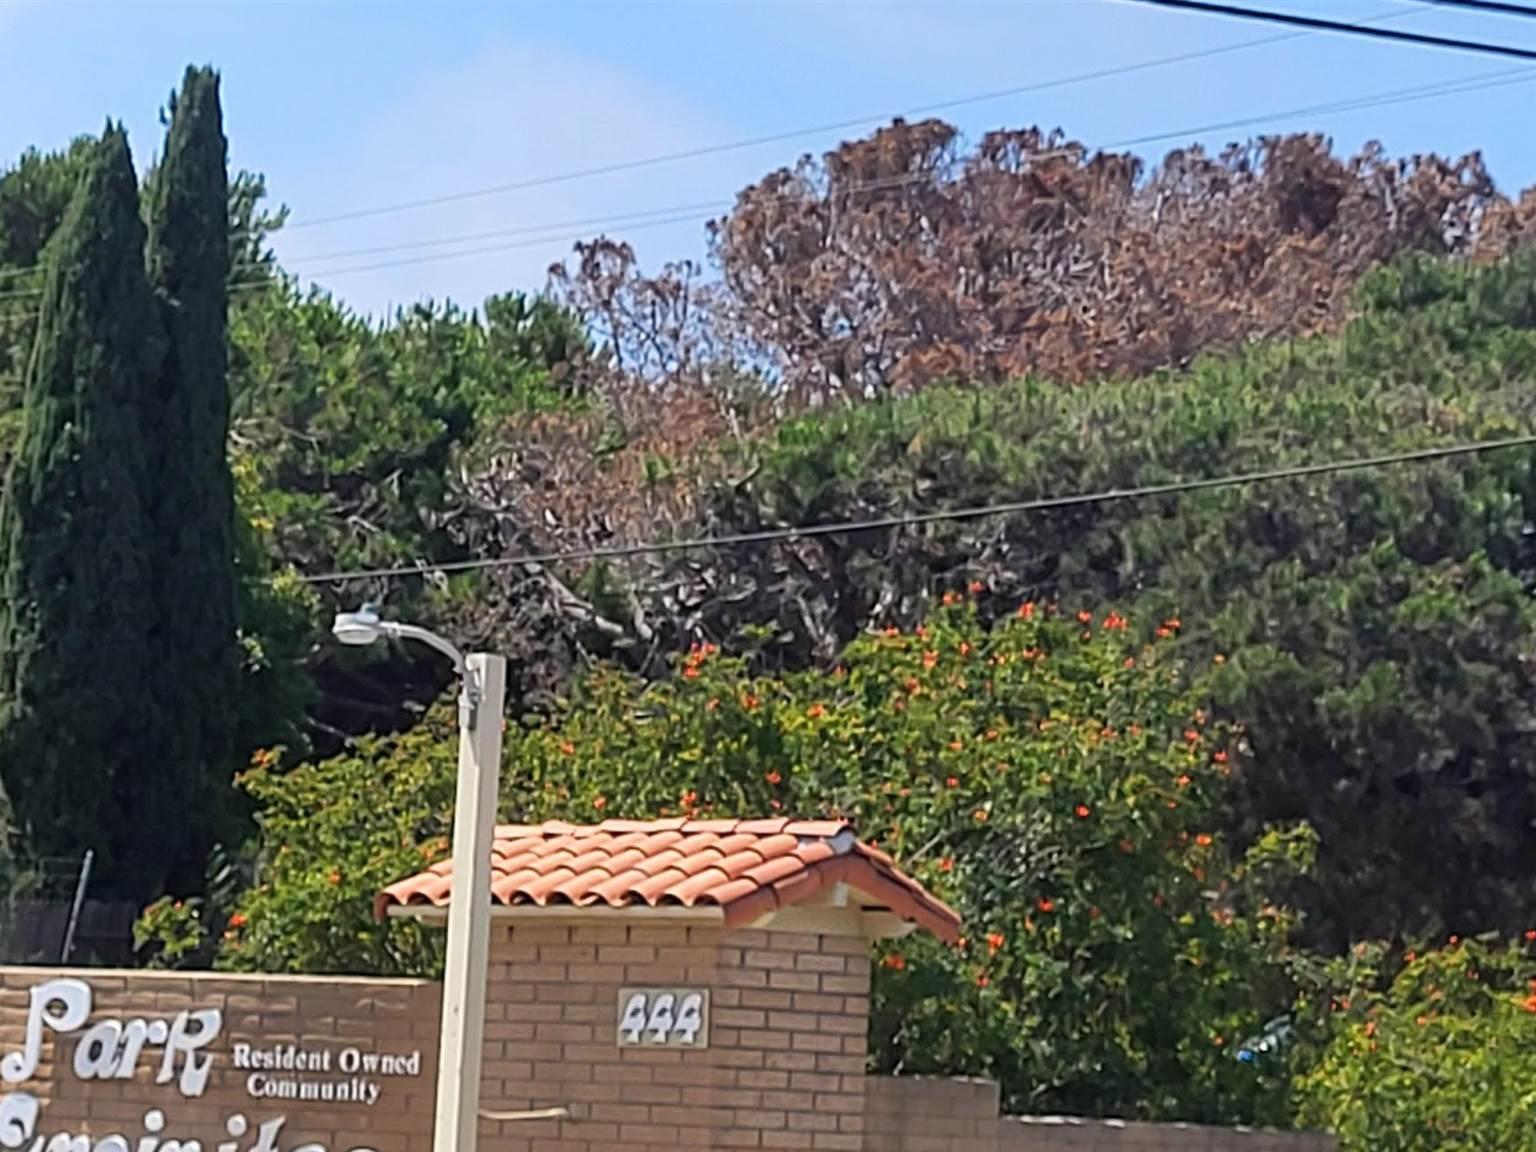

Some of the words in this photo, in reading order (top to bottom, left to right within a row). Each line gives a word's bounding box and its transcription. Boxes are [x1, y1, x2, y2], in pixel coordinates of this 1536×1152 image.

[0, 977, 222, 1096] Park
[619, 992, 704, 1045] 444
[233, 1043, 331, 1074] Resident
[338, 1047, 421, 1076] Owned
[247, 1075, 382, 1105] Community
